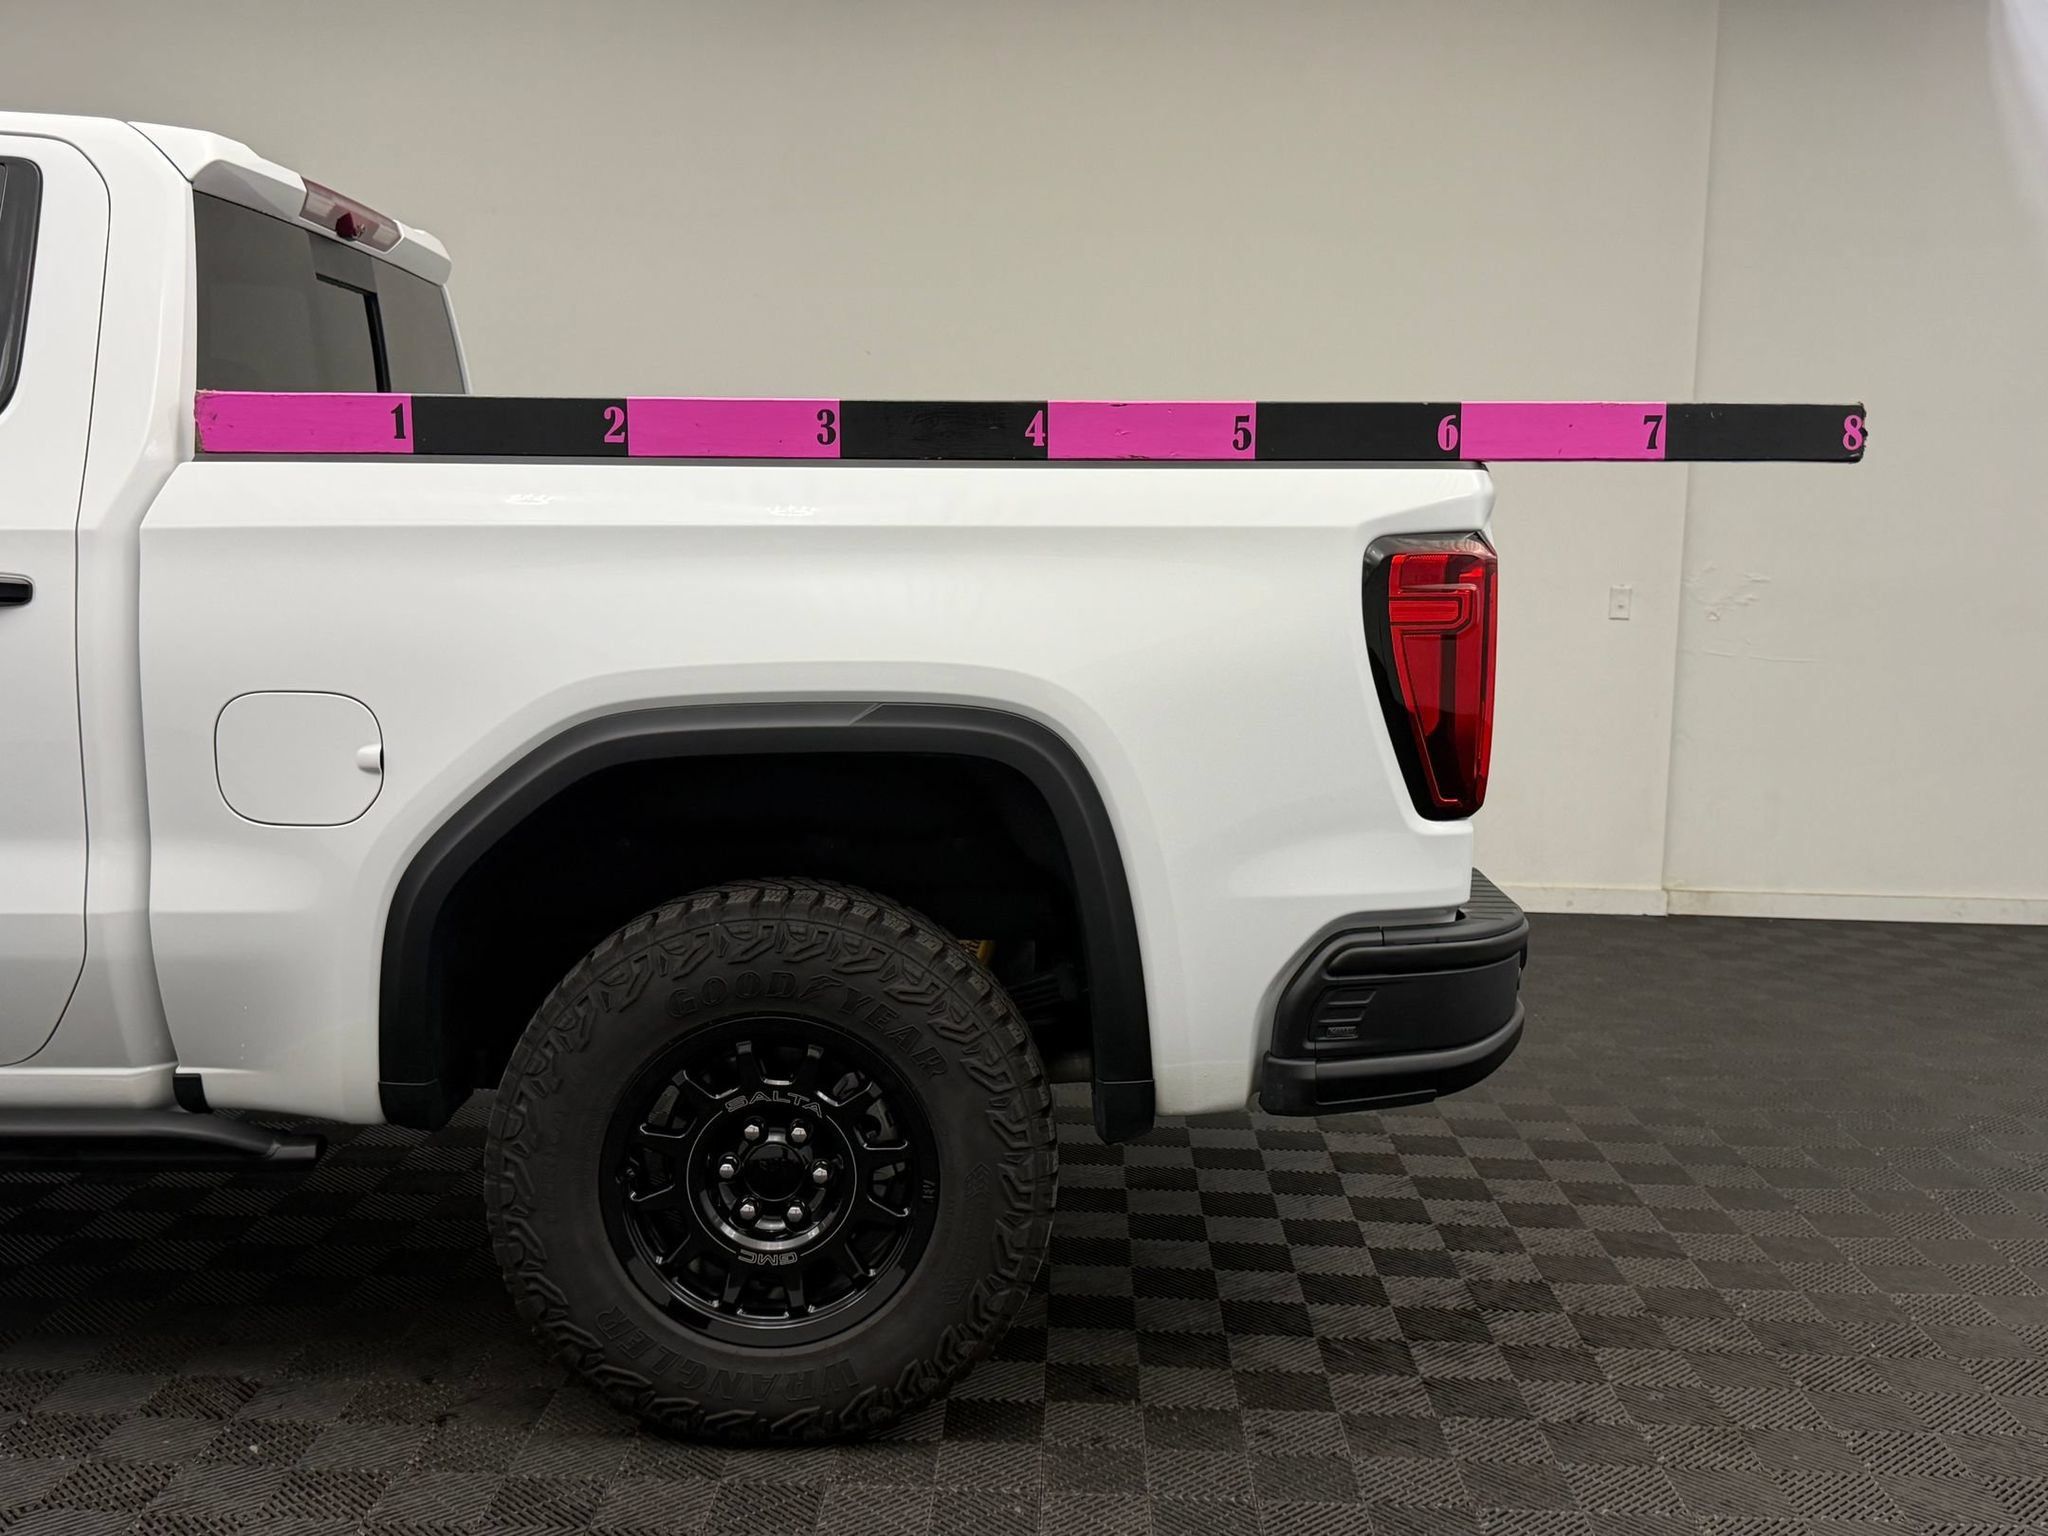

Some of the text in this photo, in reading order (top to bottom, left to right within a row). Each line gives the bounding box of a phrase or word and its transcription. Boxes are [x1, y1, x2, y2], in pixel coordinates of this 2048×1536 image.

[390, 402, 1864, 451] 1 2 3 4 5 6 7 8
[724, 1090, 823, 1119] SALTA
[737, 1248, 799, 1267] GMC
[594, 1304, 861, 1402] WRANGLER
